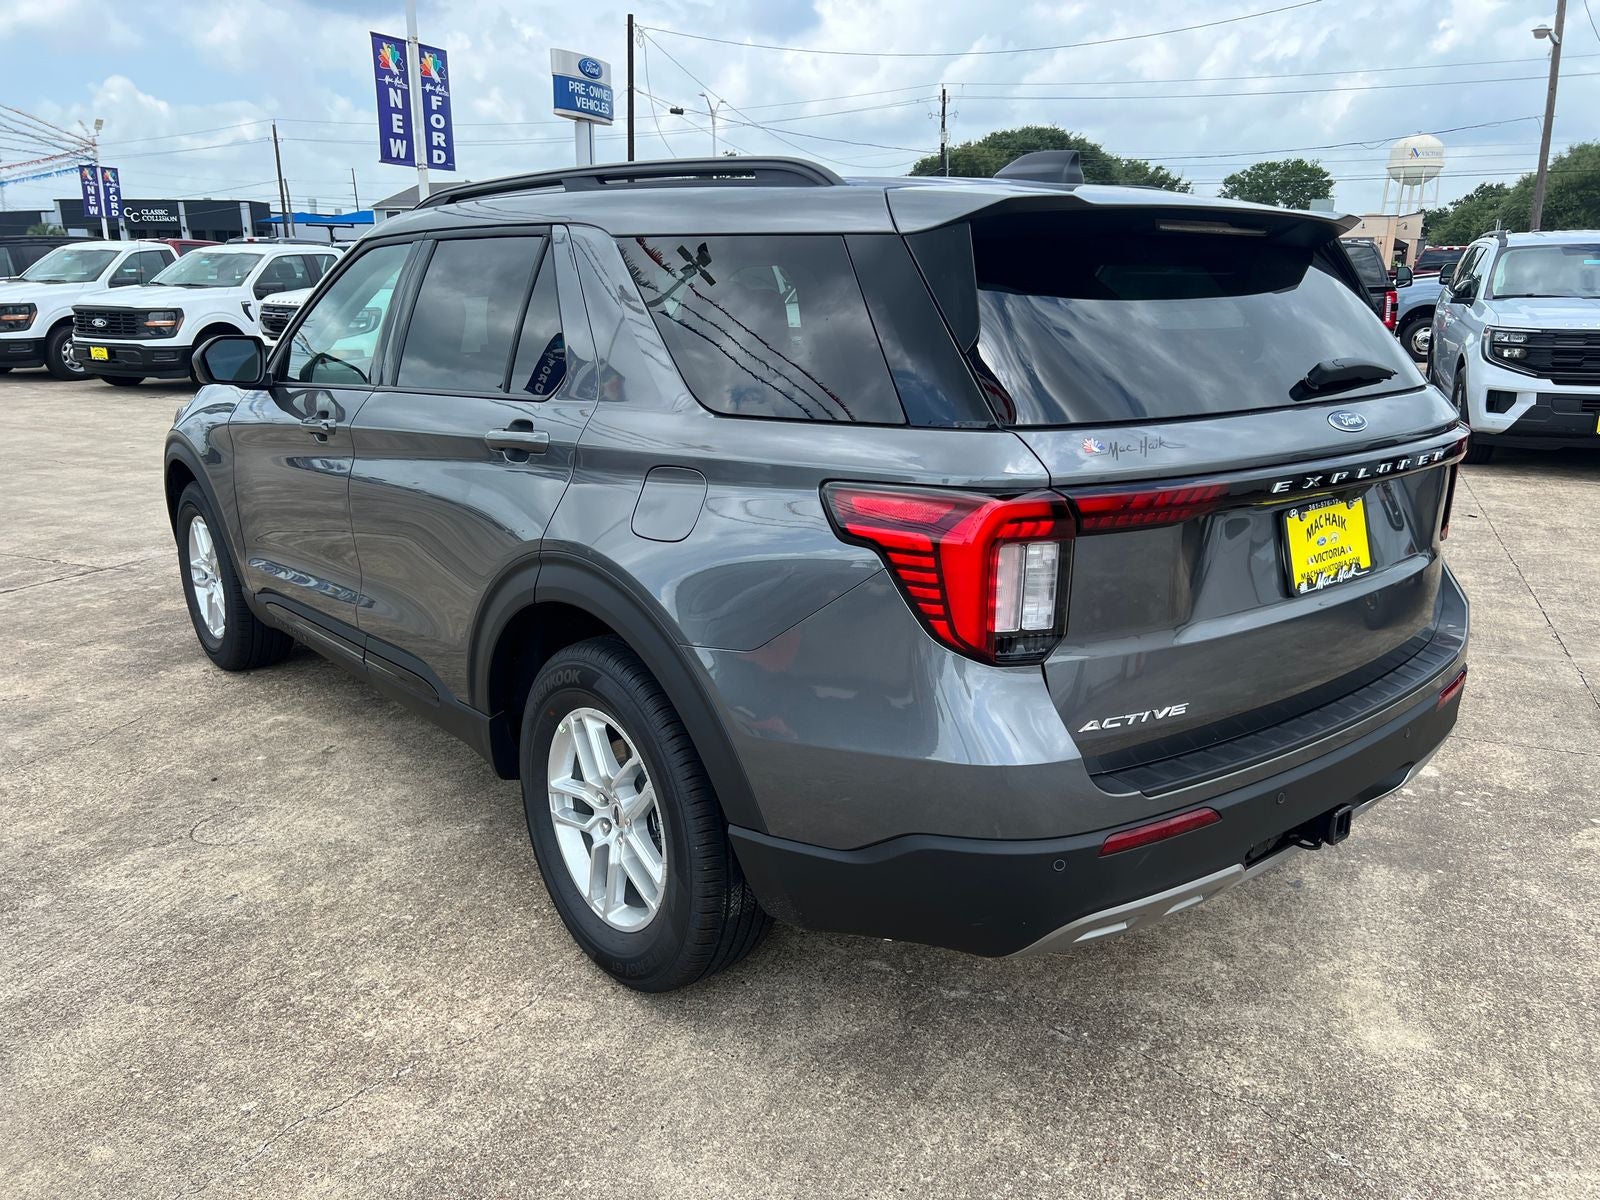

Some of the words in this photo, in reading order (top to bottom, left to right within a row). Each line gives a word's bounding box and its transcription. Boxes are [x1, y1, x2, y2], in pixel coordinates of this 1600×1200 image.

[568, 80, 611, 102] PRE-OWNED
[575, 95, 610, 115] VEHICLES
[388, 87, 407, 159] NEW
[430, 95, 447, 165] FORD
[87, 185, 99, 215] NEW
[109, 187, 119, 216] FORD
[1338, 412, 1362, 427] Ford
[1103, 441, 1138, 461] Mac
[1139, 436, 1179, 458] Haik
[1270, 450, 1446, 494] EXPLORER
[1306, 515, 1324, 542] MAC
[1324, 512, 1347, 531] HAIK
[1313, 545, 1346, 564] VICTORIA
[1308, 571, 1338, 591] Mac
[1077, 702, 1190, 733] ACTIVE
